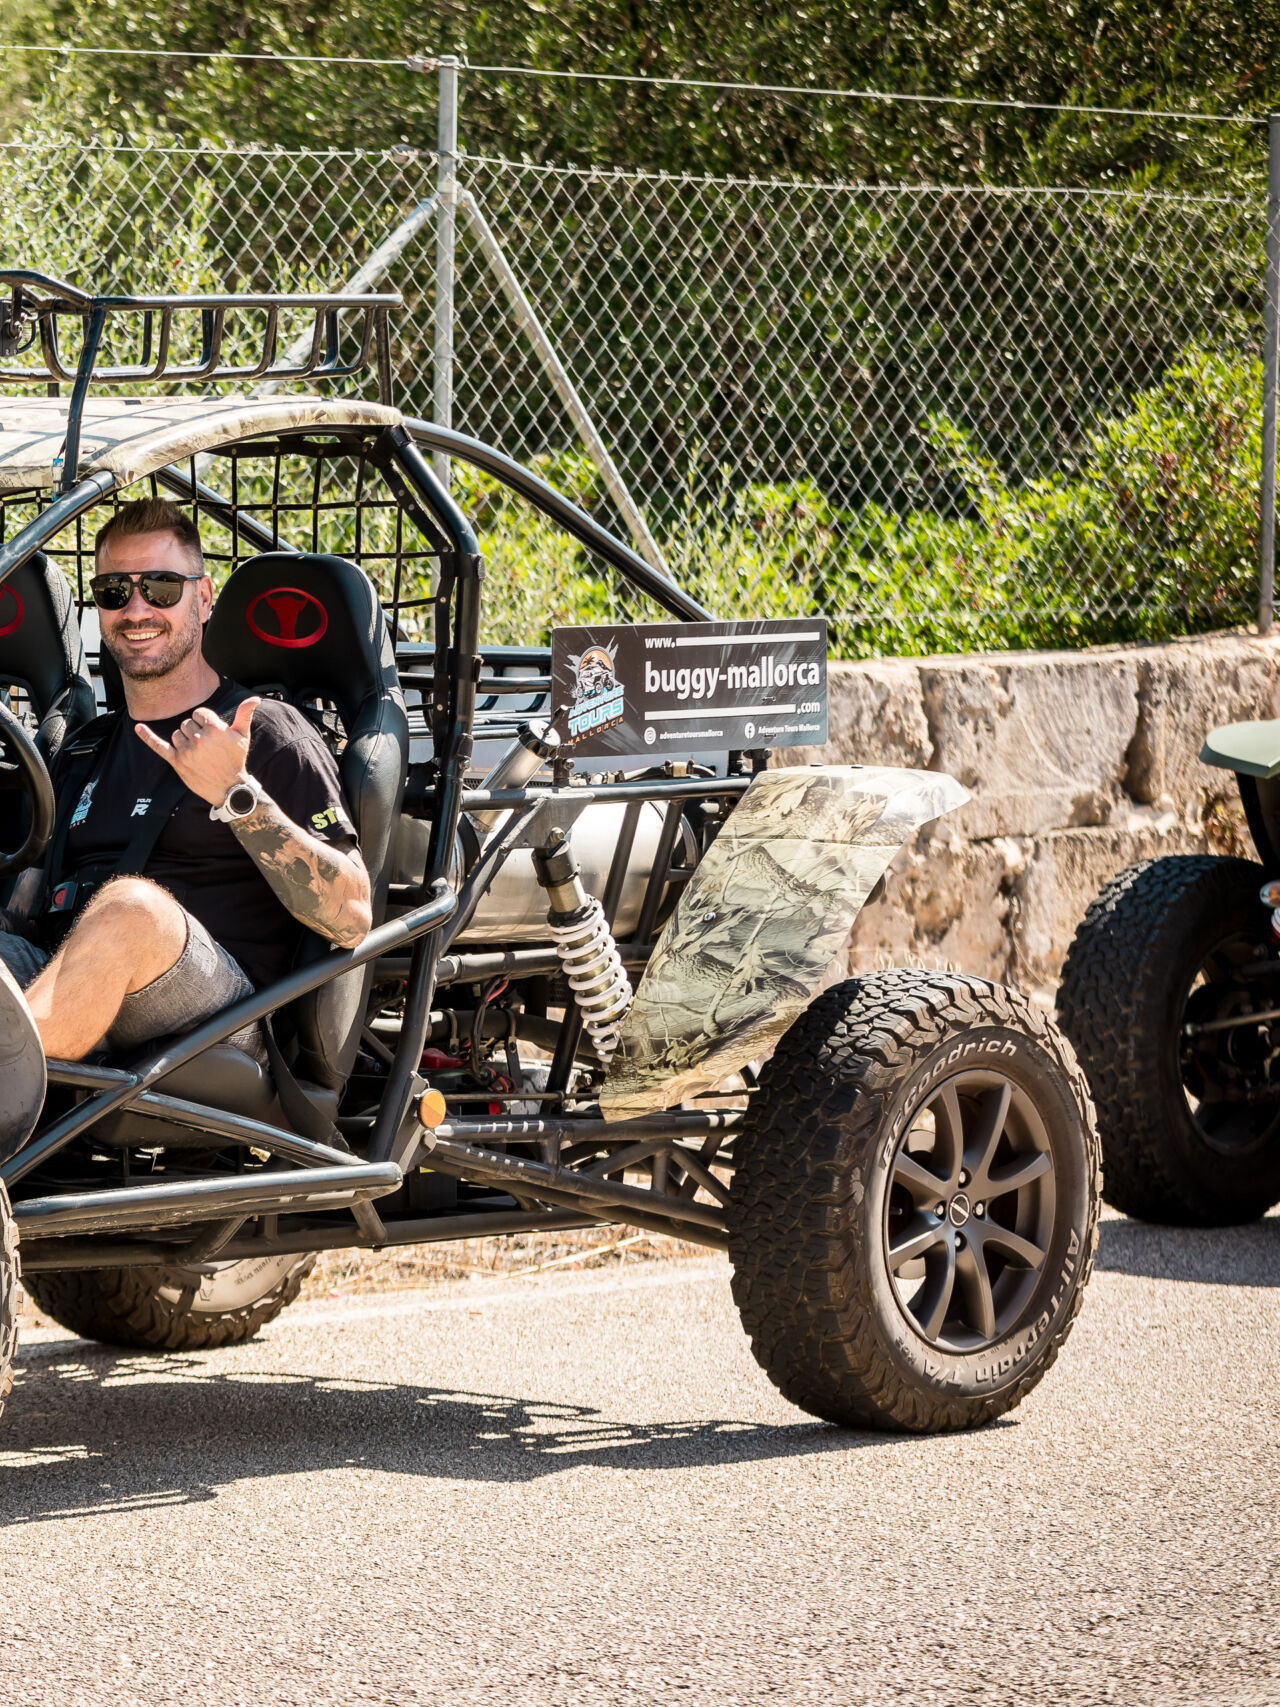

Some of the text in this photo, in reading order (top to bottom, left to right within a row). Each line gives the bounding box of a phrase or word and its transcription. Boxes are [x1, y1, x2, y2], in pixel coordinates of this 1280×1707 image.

[644, 637, 676, 649] www.
[644, 655, 820, 700] buggy-mallorca
[567, 696, 624, 738] TOURS
[796, 702, 821, 715] .com
[567, 716, 624, 745] MALLORCA
[879, 1037, 1018, 1169] BFGoodrich
[974, 1227, 1080, 1384] All-Terrain
